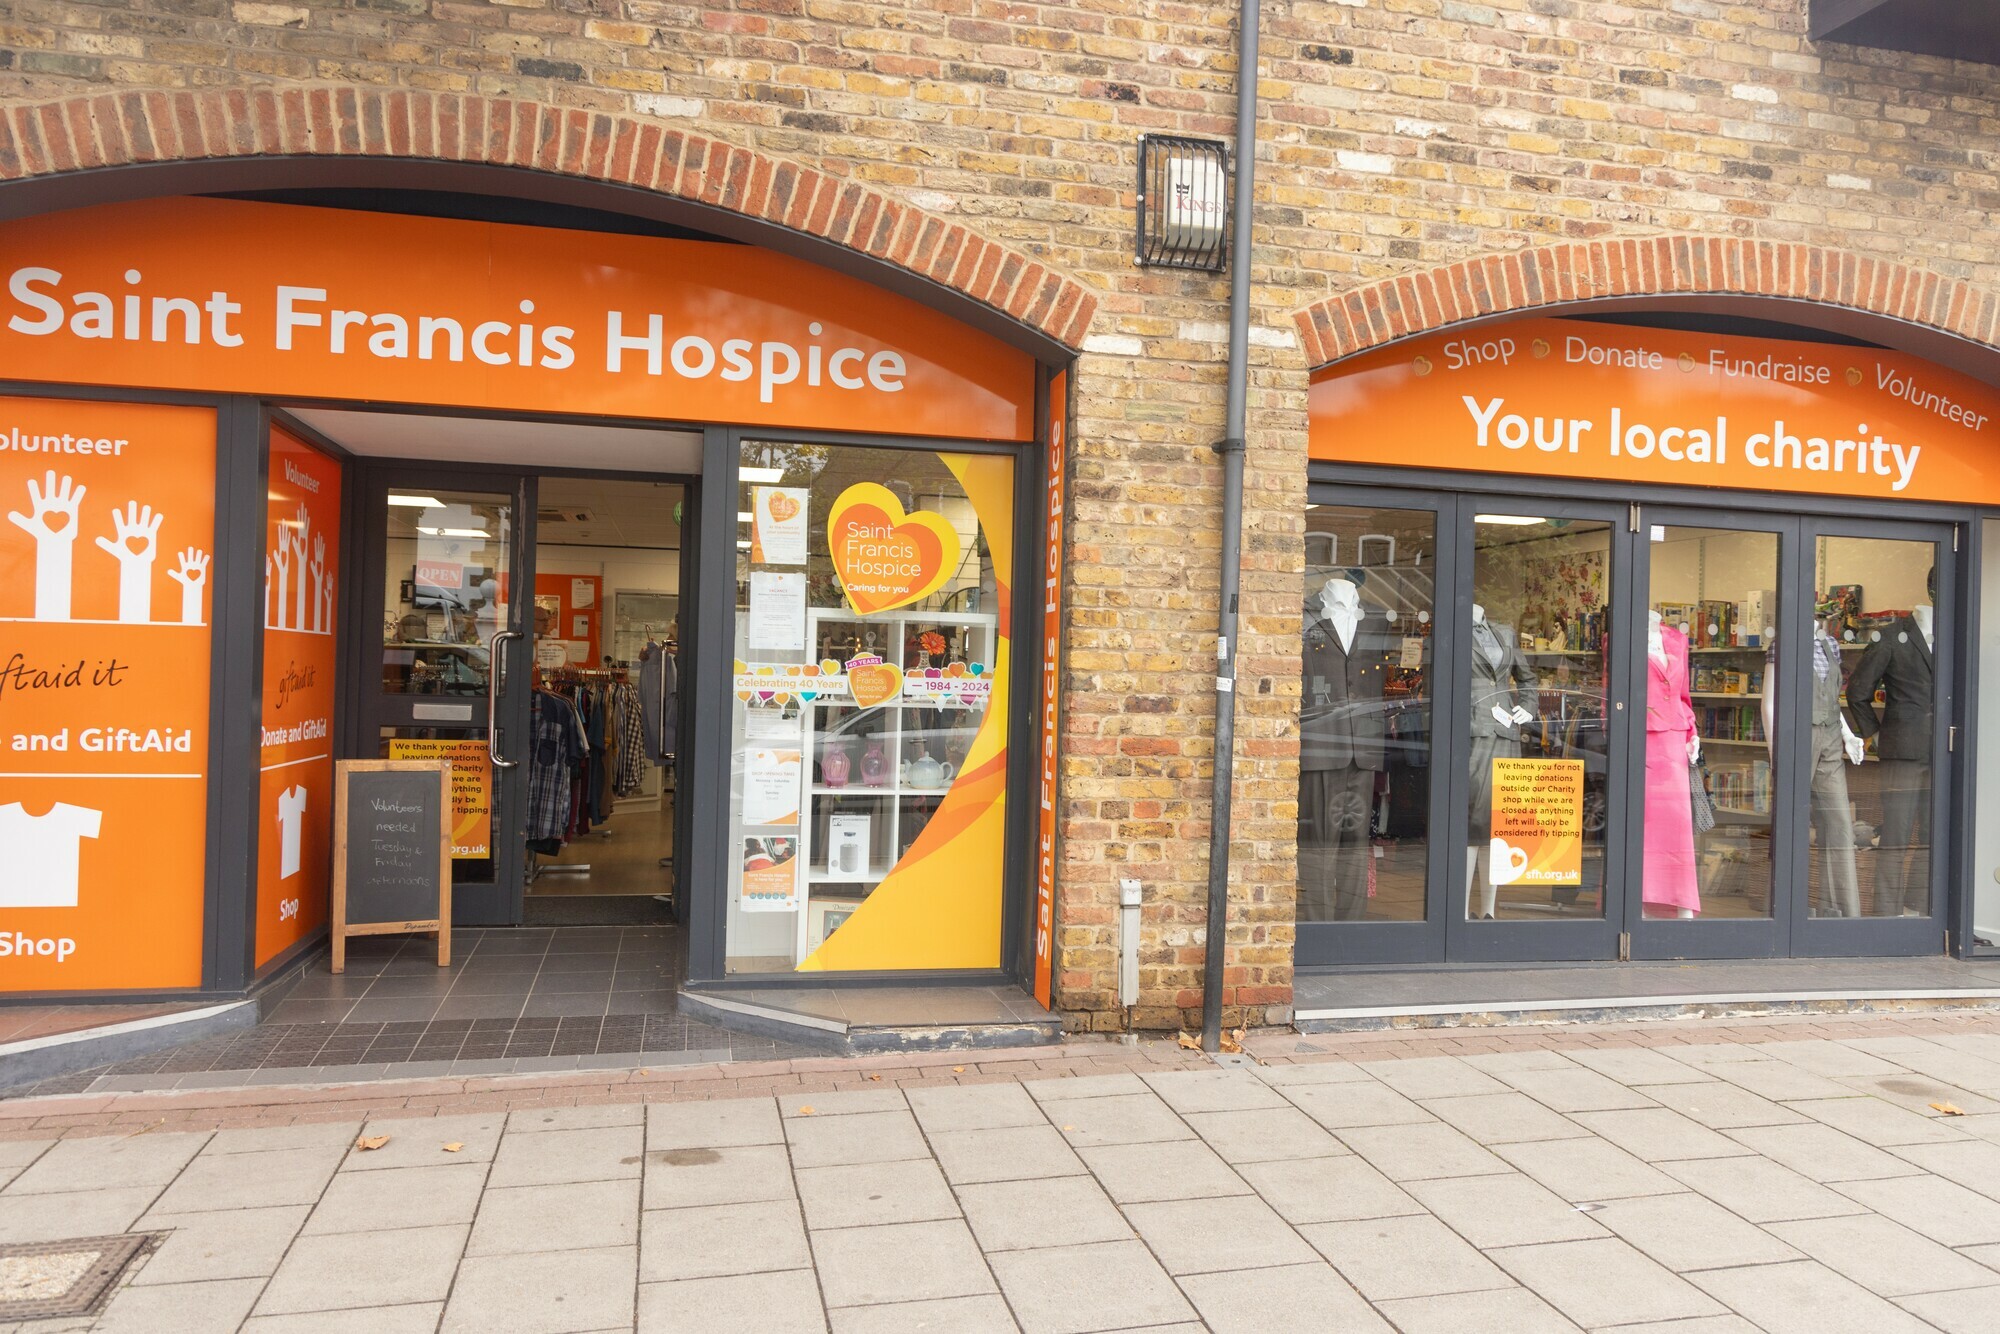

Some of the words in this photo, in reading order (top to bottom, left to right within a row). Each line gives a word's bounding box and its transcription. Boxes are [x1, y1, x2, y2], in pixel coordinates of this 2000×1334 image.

[8, 266, 244, 347] Saint
[276, 284, 575, 370] Francis
[606, 310, 907, 403] Hospice
[1443, 337, 1516, 370] Shop
[1565, 336, 1663, 370] Donate
[1708, 348, 1830, 384] Fundraise
[1876, 362, 1988, 431] Volunteer
[0, 427, 129, 456] olunteer
[1462, 395, 1593, 453] Your
[1610, 407, 1726, 464] local
[1744, 420, 1921, 491] charity
[284, 458, 320, 494] Volunteer
[1045, 420, 1062, 613] Hospice
[847, 521, 894, 540] Saint
[847, 539, 913, 559] Francis
[419, 567, 460, 582] OPEN
[846, 558, 921, 578] Hospice
[847, 583, 876, 593] Caring
[878, 584, 890, 592] for
[893, 586, 909, 594] you
[0, 653, 86, 700] ftaid
[92, 659, 129, 687] it
[856, 669, 876, 677] Saint
[736, 677, 797, 690] Celebrating
[799, 678, 813, 689] 40
[816, 679, 844, 689] Years
[856, 677, 884, 685] Francis
[925, 681, 951, 691] 1984
[962, 682, 989, 692] 2024
[856, 684, 888, 692] Hospice
[1041, 636, 1055, 812] Francis
[11, 728, 69, 751] and
[79, 726, 192, 752] GiftAid
[261, 725, 287, 747] Donate
[288, 721, 302, 743] and
[303, 718, 327, 740] GiftAid
[413, 743, 438, 751] thank
[437, 754, 481, 762] donations
[452, 765, 484, 773] Charity
[1497, 762, 1511, 770] We
[1513, 762, 1535, 770] thank
[1554, 763, 1565, 771] for
[1503, 774, 1532, 782] leaving
[1534, 774, 1573, 782] donations
[451, 786, 482, 794] ything
[1547, 785, 1576, 793] Charity
[371, 798, 423, 814] Volunteers
[1503, 796, 1522, 804] shop
[457, 806, 489, 815] tipping
[1540, 807, 1574, 815] anything
[376, 822, 416, 833] needed
[1536, 818, 1557, 827] sadly
[1540, 829, 1550, 837] fly
[1552, 829, 1580, 838] tipping
[371, 839, 412, 856] Tuesday
[450, 844, 486, 855] org.uk
[375, 858, 411, 872] Friday
[1526, 869, 1578, 880] sfh.org.uk
[1037, 833, 1051, 960] Saint
[280, 898, 299, 921] Shop
[0, 931, 76, 963] Shop
